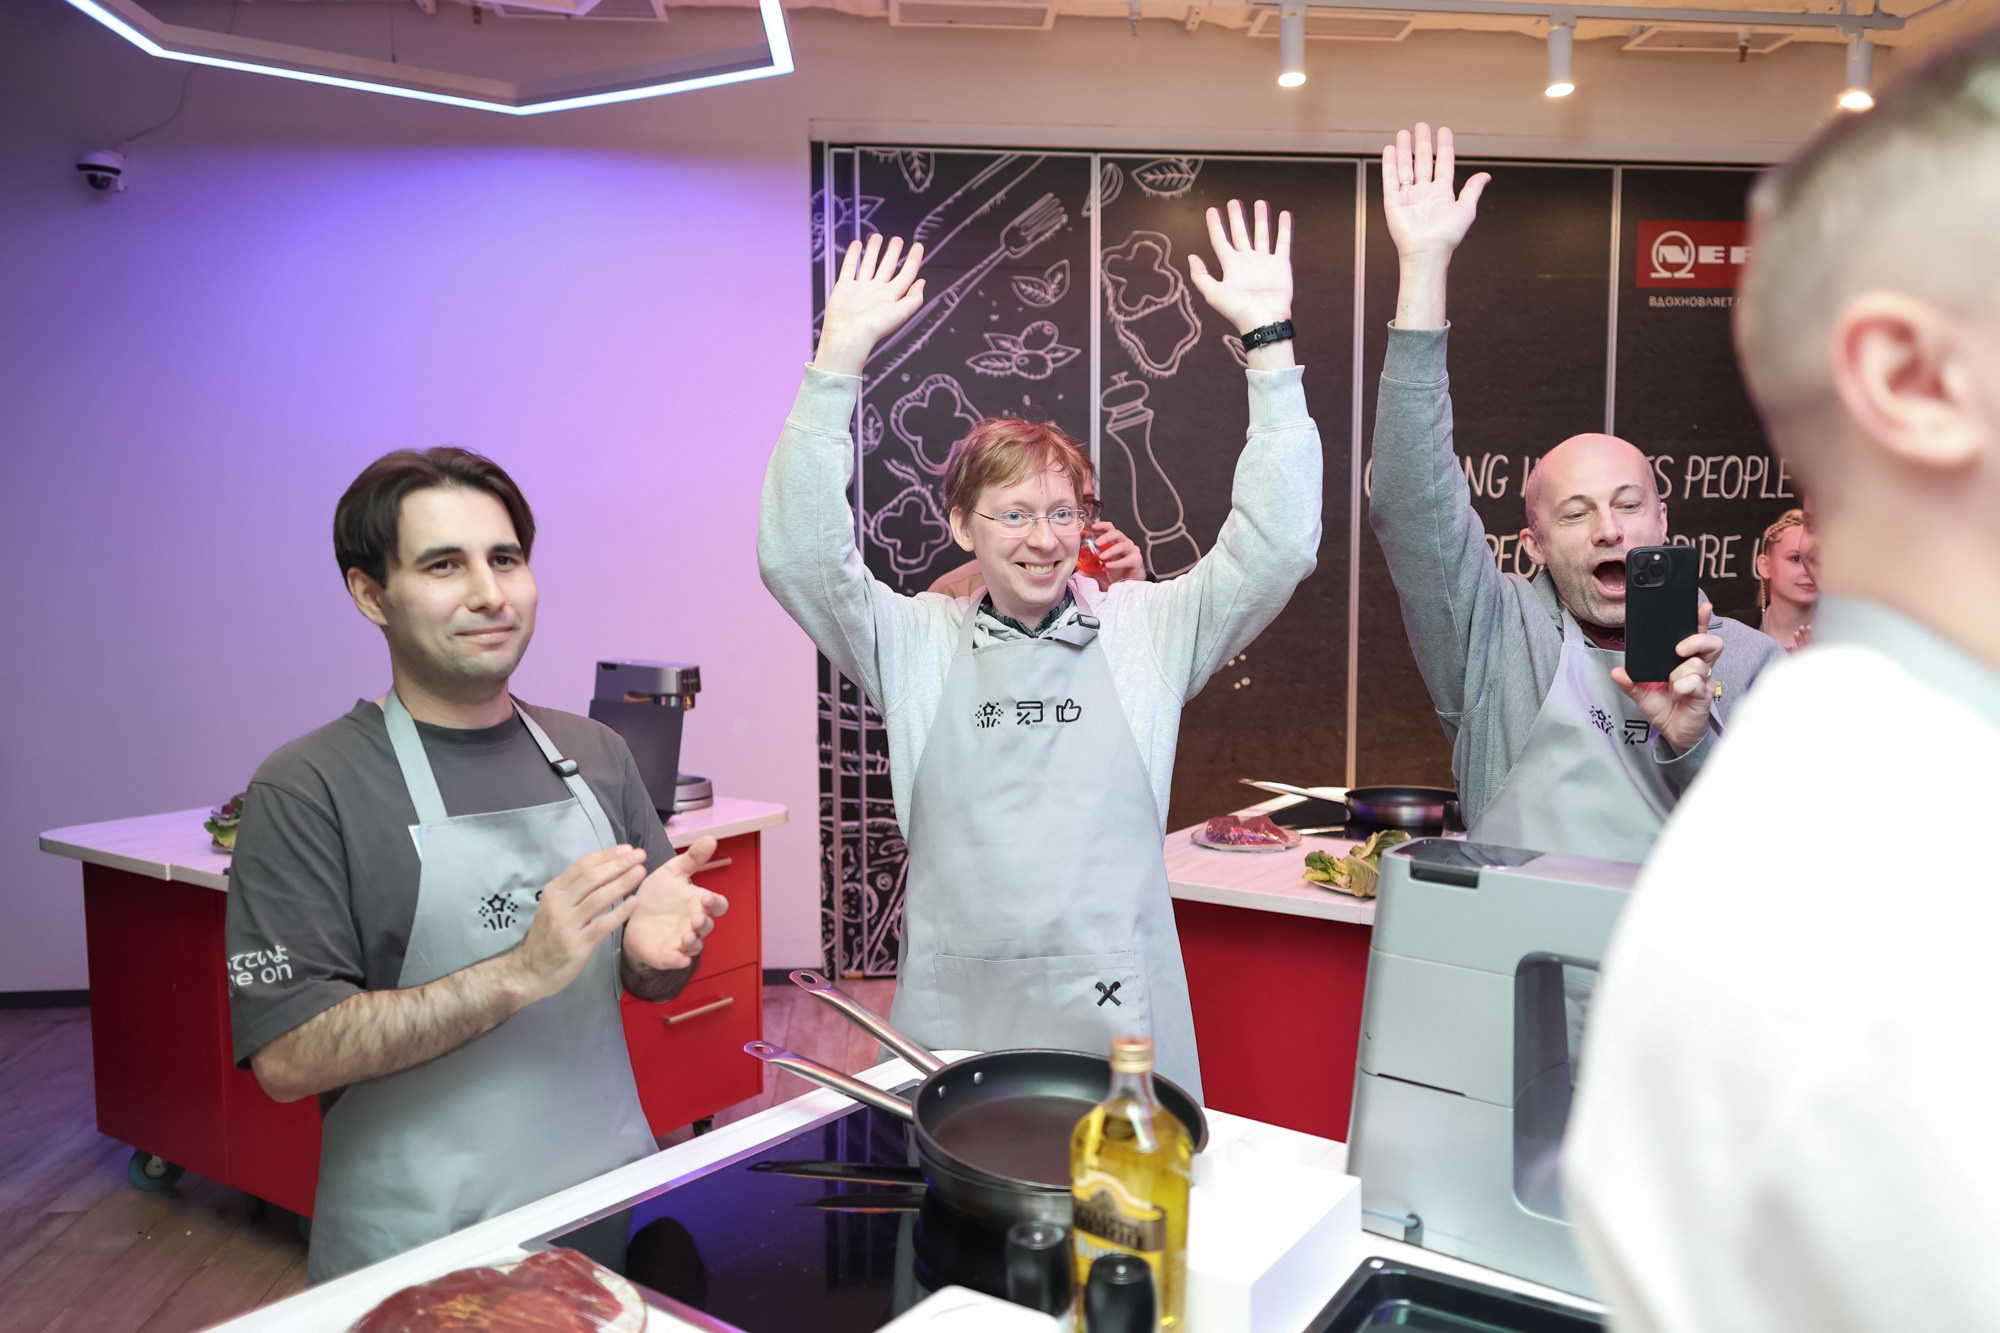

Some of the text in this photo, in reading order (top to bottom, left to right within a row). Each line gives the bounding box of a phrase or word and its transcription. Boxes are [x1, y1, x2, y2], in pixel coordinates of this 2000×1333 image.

[1648, 295, 1733, 308] ВДОХНОВЛЯЕТ
[1684, 454, 1795, 500] PEOPLE
[227, 944, 290, 971] てこいよ
[260, 963, 293, 984] on
